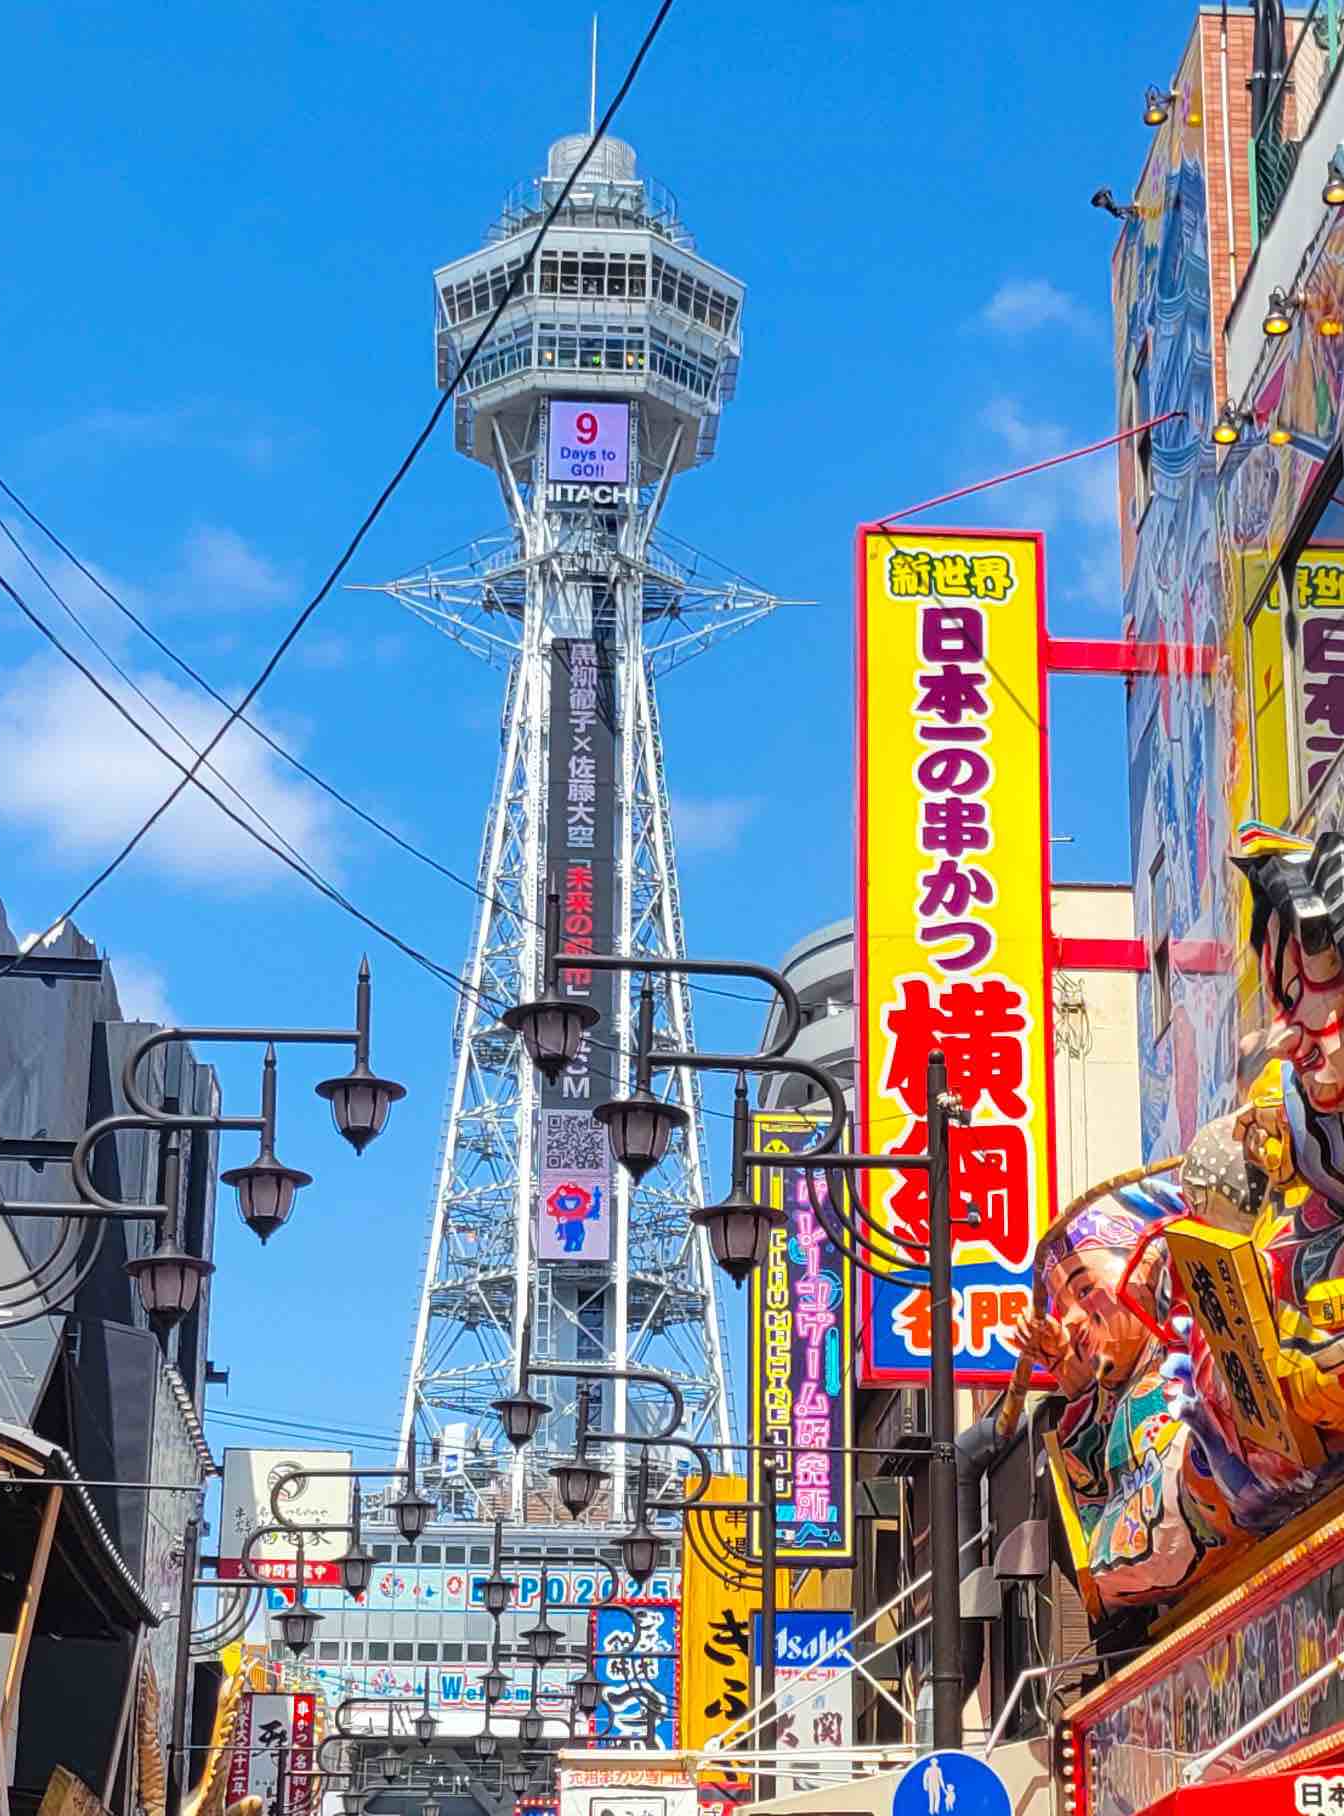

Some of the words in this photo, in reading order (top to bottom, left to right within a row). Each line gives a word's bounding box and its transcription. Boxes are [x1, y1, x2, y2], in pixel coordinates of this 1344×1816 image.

[575, 412, 599, 445] 9
[560, 446, 597, 462] Days
[601, 448, 617, 460] to
[570, 463, 605, 478] GO!!
[542, 484, 638, 504] HITACHI
[890, 554, 1014, 600] 新世界
[917, 606, 994, 971] 日本一の串かつ
[885, 979, 1030, 1266] 横綱
[575, 1575, 669, 1602] 2025
